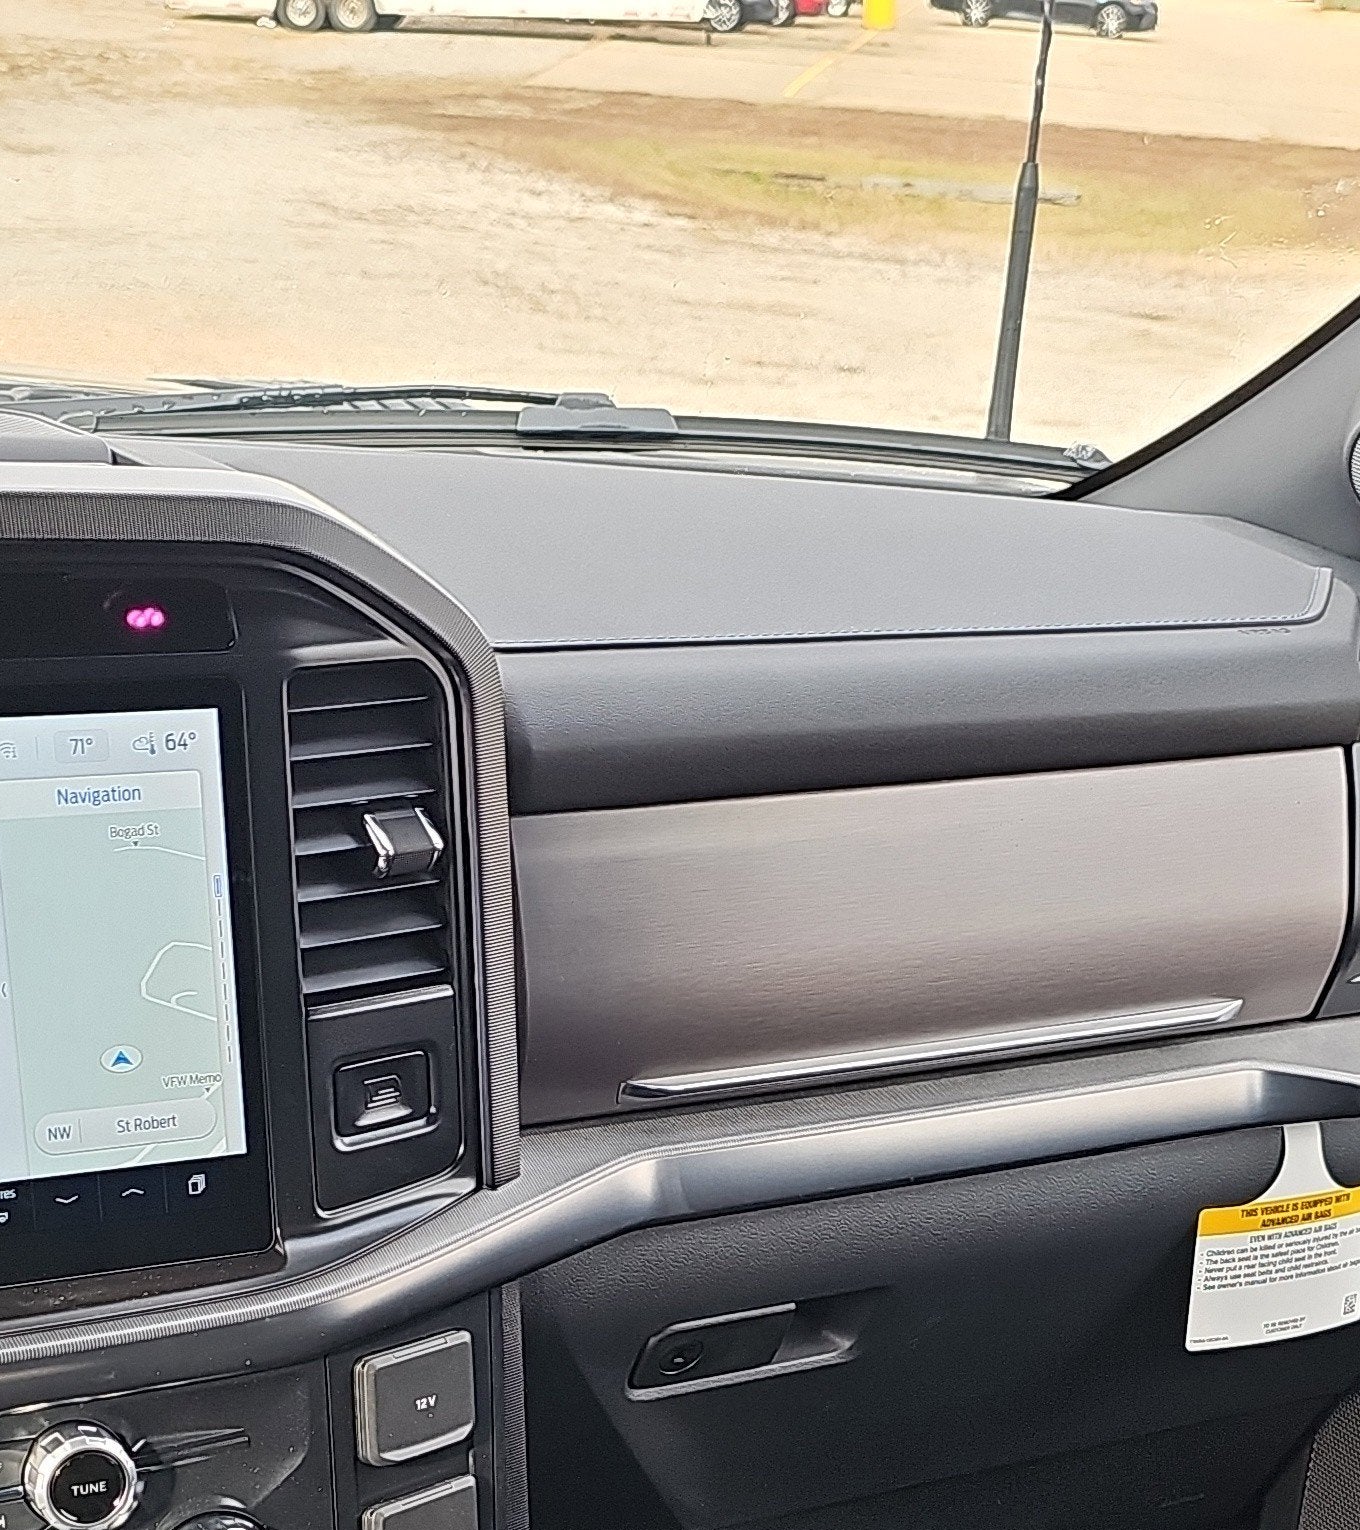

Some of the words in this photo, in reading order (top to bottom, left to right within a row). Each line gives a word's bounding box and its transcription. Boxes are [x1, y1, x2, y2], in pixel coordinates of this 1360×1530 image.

[69, 736, 94, 755] 71°
[164, 731, 197, 751] 64°
[56, 786, 142, 807] Navigation
[109, 824, 145, 841] Bogad
[146, 822, 159, 837] St
[162, 1075, 188, 1089] VFW
[189, 1072, 222, 1085] Memo
[47, 1125, 72, 1142] NW
[117, 1118, 131, 1134] St
[134, 1114, 177, 1131] Robert
[1240, 1208, 1259, 1218] THIS
[1260, 1203, 1290, 1216] VEHICLE
[1300, 1197, 1333, 1210] EQUIPPED
[1261, 1214, 1300, 1228] ADVANCED
[1300, 1211, 1313, 1222] AIR
[1314, 1208, 1332, 1220] BAGS
[71, 1480, 107, 1497] TUNE
